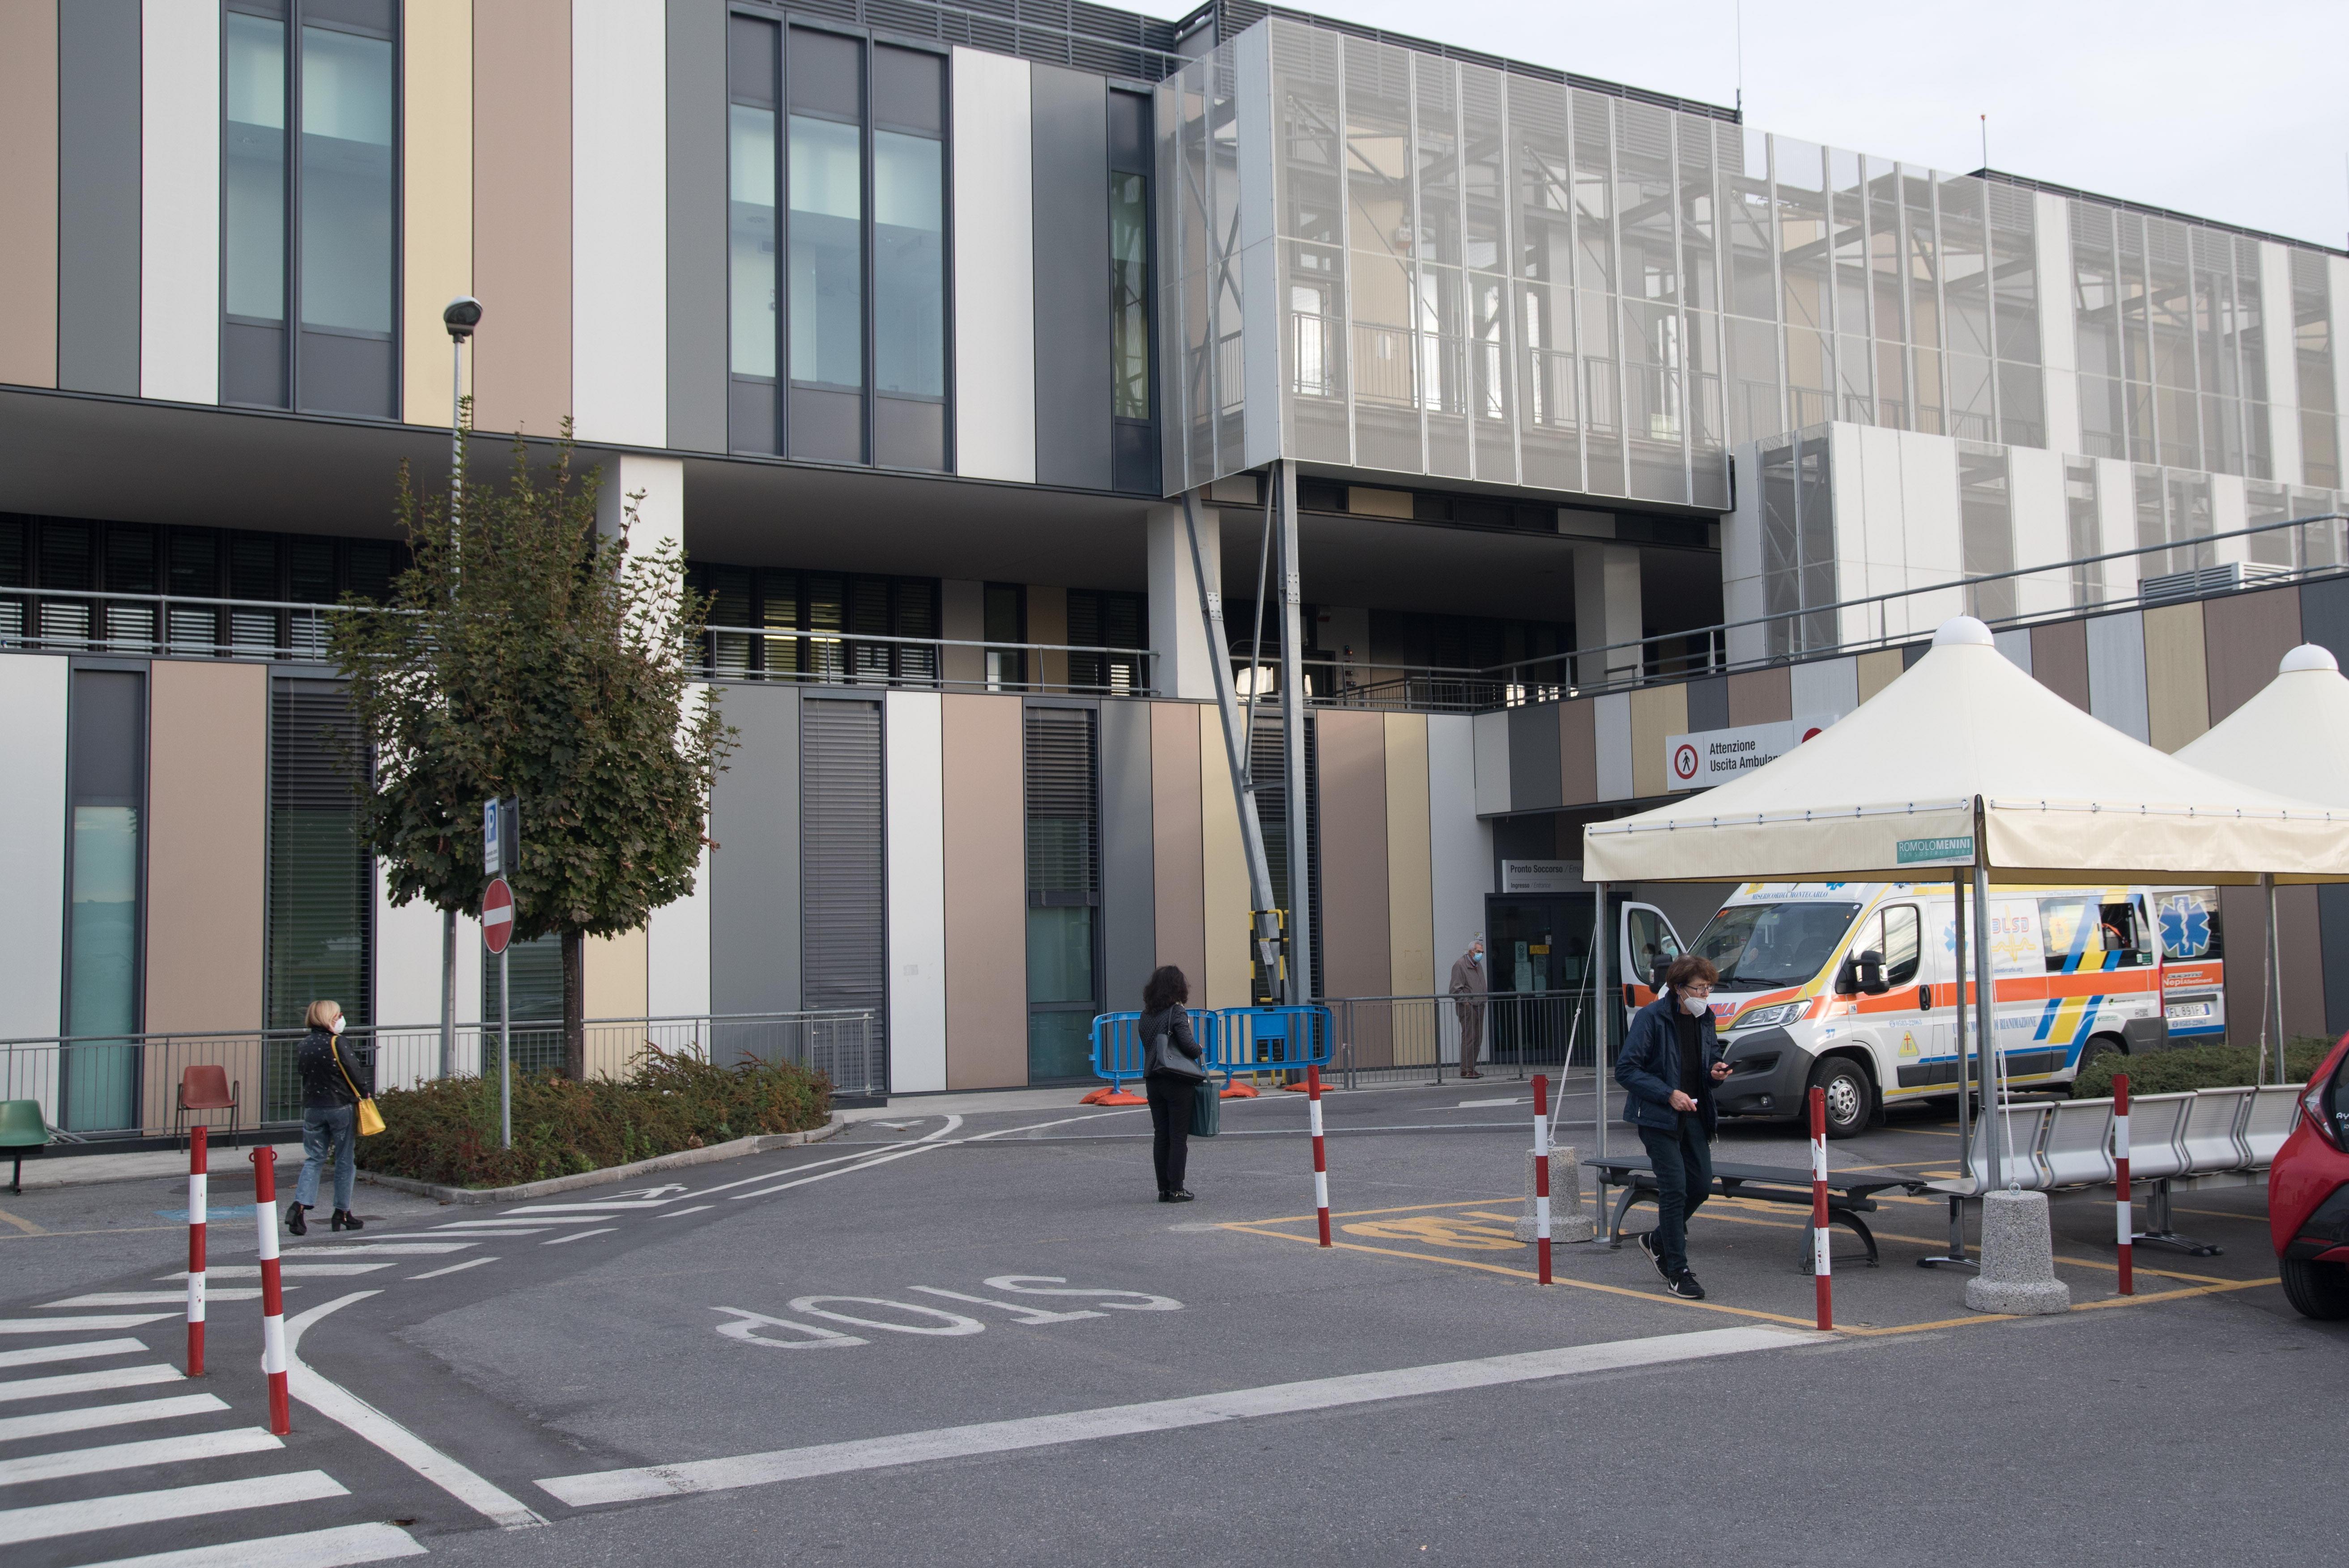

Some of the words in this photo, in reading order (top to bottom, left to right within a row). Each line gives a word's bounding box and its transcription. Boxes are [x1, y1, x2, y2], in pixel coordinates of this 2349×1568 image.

[1710, 740, 1755, 755] Attenzione
[1710, 758, 1736, 772] Uscita
[1739, 754, 1781, 769] Ambula
[488, 809, 494, 839] P
[1511, 865, 1532, 873] Pronto
[1533, 865, 1563, 873] Soccorso
[1751, 892, 1788, 900] MISERICORDIA
[1992, 917, 2029, 934] BLSD
[2000, 1016, 2037, 1029] RIANIMAZIONE
[1826, 1028, 1835, 1038] 37
[709, 1275, 1186, 1349] STOP
